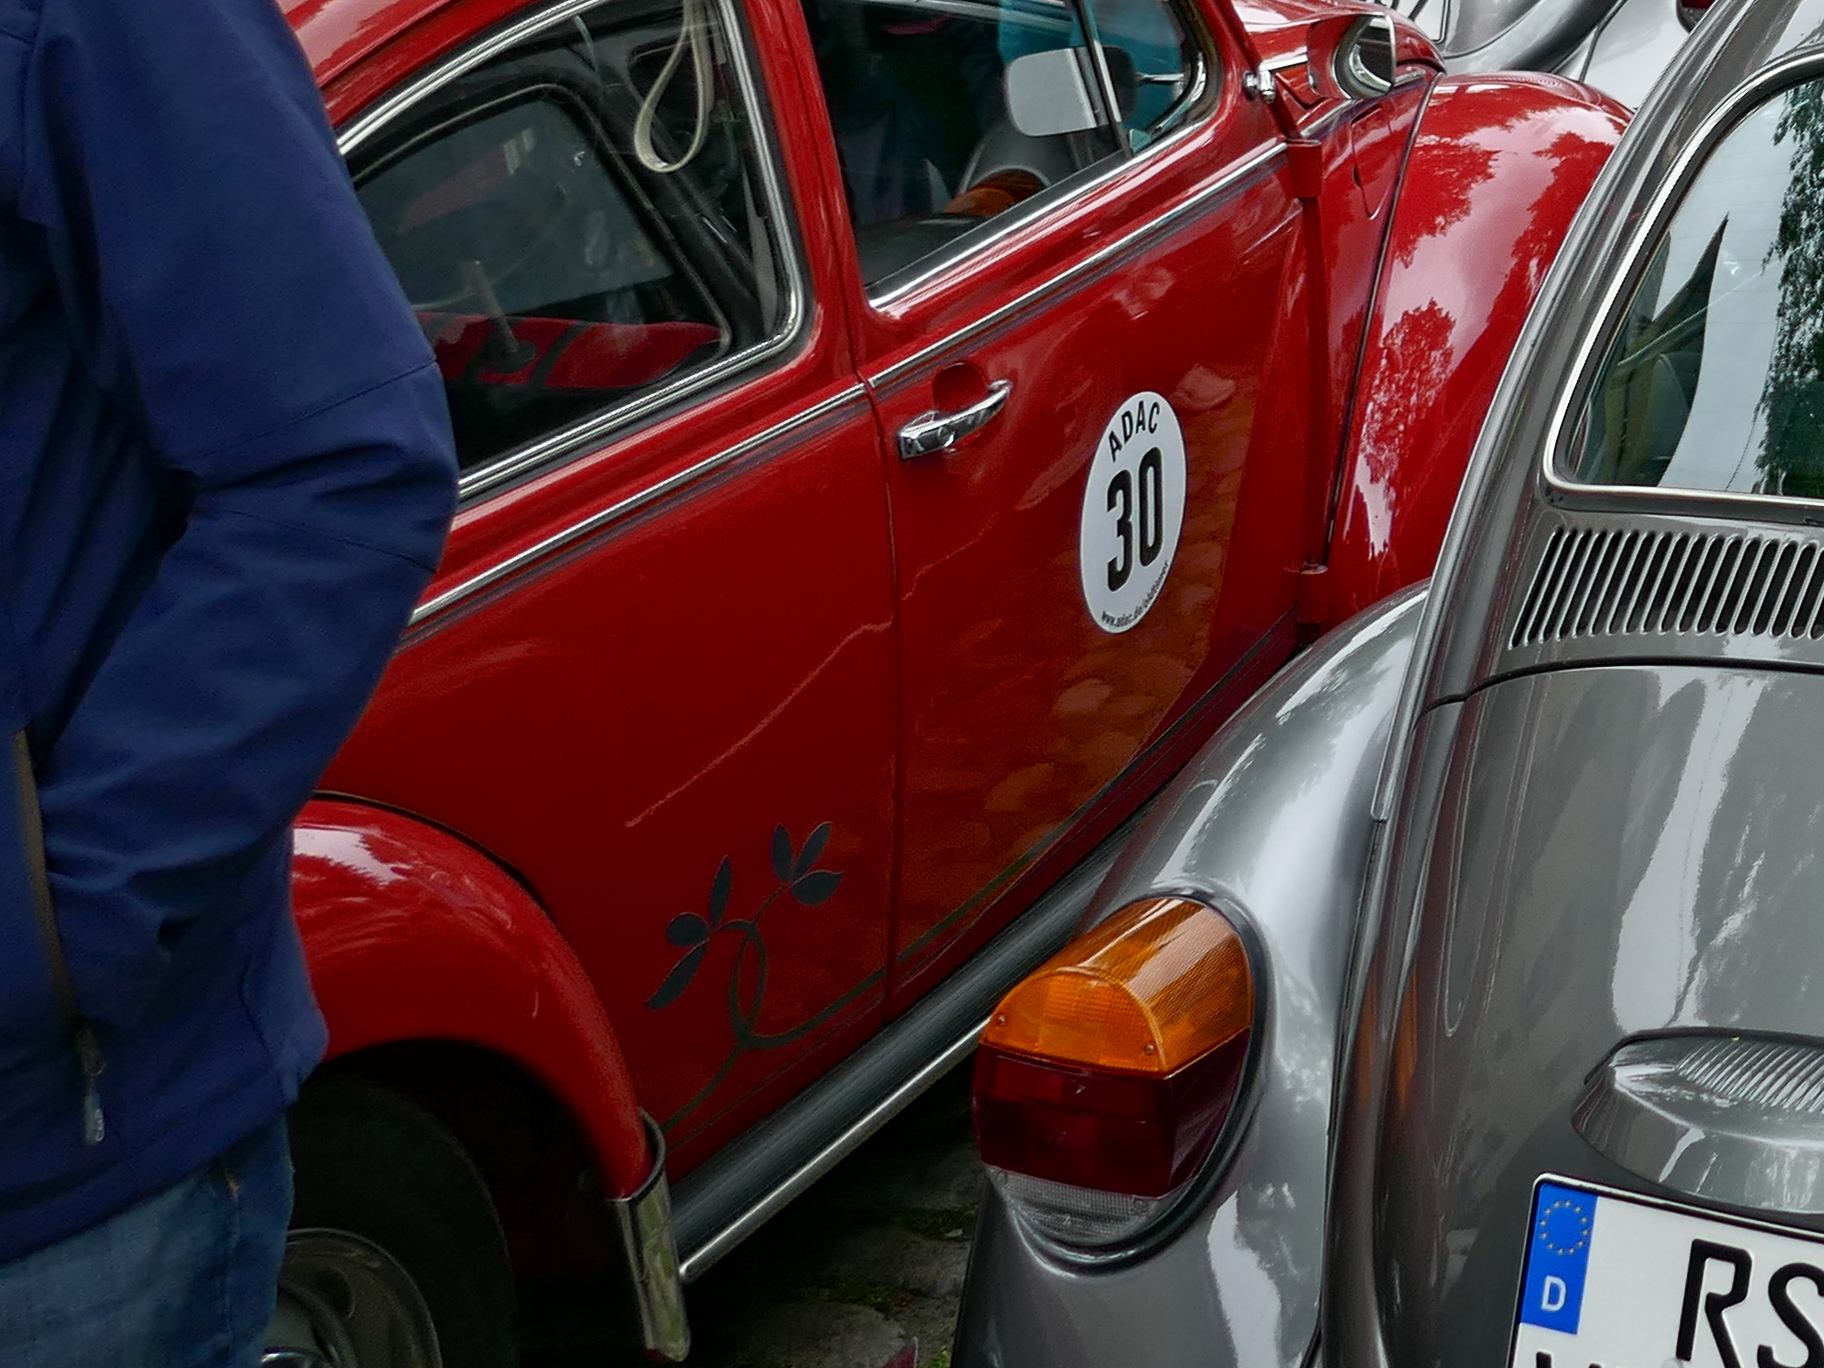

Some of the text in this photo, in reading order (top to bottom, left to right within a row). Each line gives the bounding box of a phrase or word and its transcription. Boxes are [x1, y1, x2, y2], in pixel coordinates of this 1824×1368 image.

[1107, 400, 1161, 463] ADAC
[1106, 446, 1164, 592] 30
[1540, 1275, 1568, 1313] D
